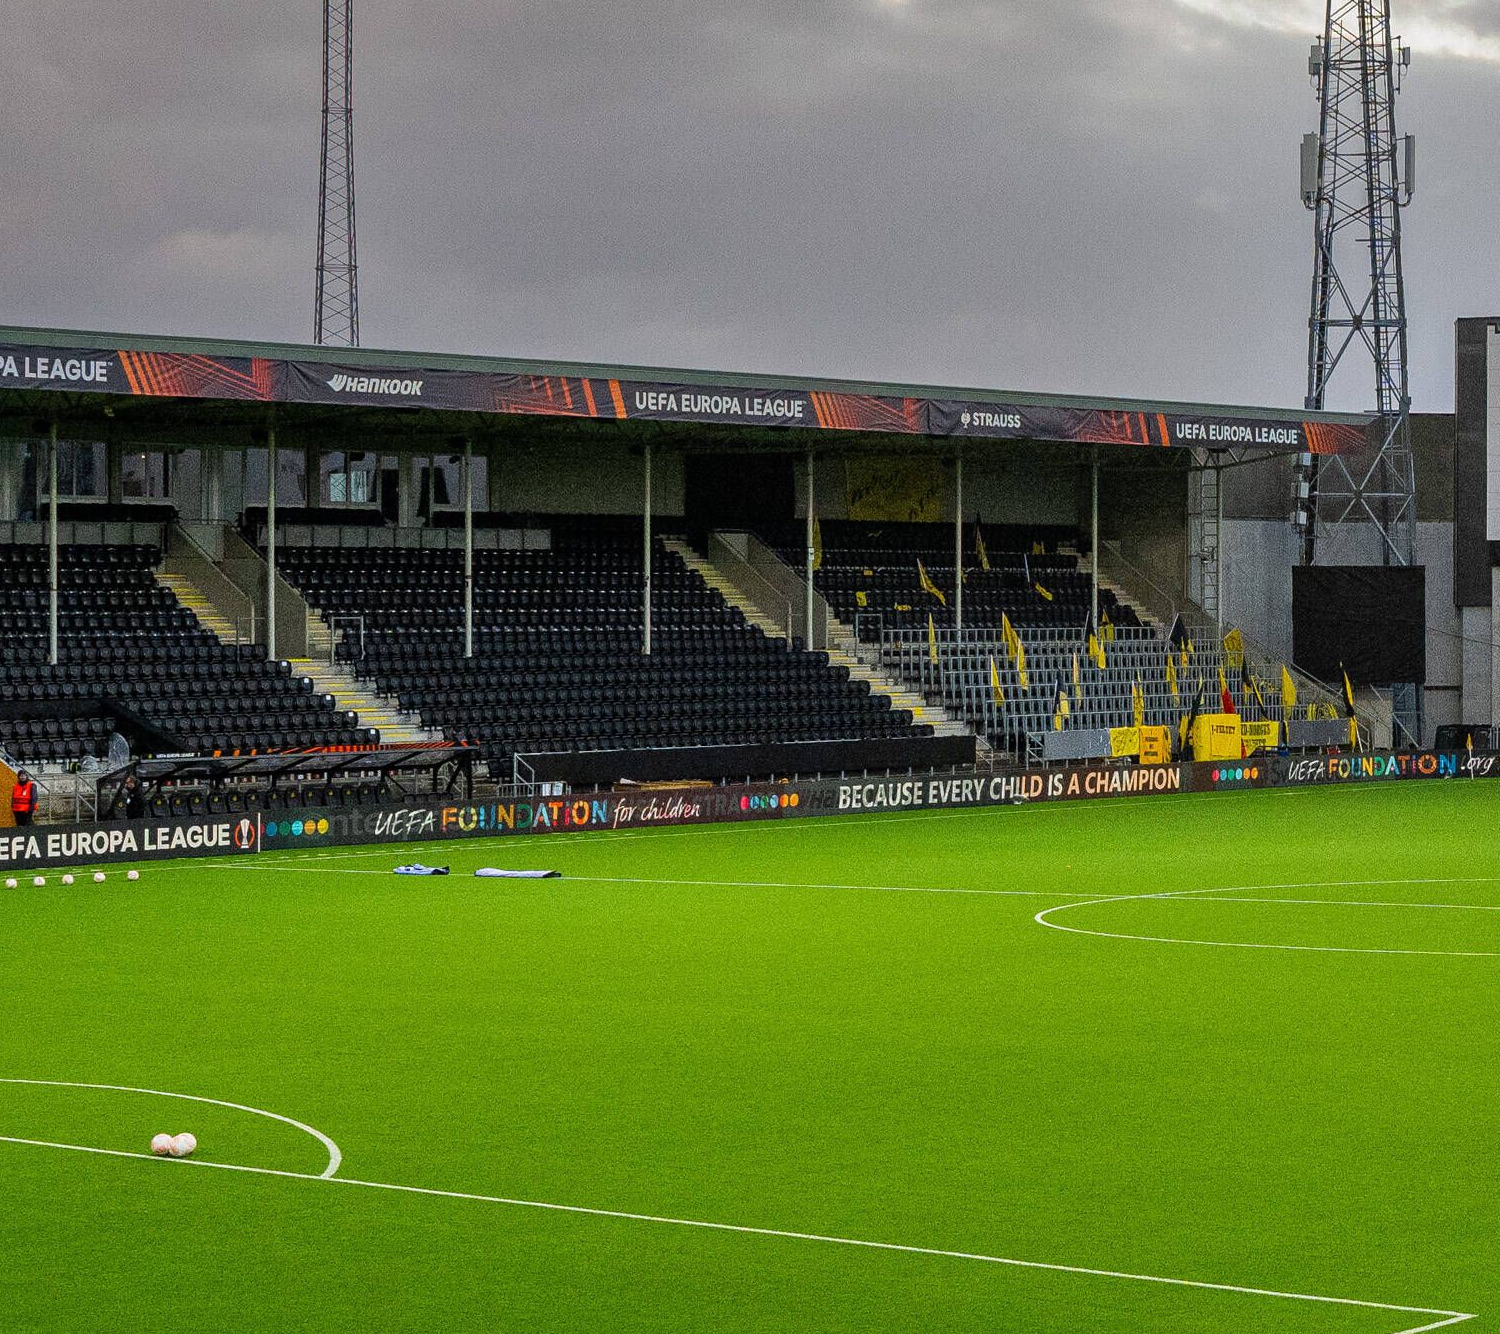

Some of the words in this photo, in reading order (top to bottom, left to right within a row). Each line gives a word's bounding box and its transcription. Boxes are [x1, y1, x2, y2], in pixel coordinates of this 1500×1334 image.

[635, 391, 678, 412] UEFA
[681, 394, 742, 415] EUROPA
[972, 412, 1021, 428] STRAUSS
[1176, 423, 1207, 440] UEFA
[1209, 425, 1253, 442] EUROPA
[1288, 760, 1326, 781] UEFA
[1328, 754, 1456, 778] FOUNDATION
[839, 781, 923, 810] BECAUSE
[928, 778, 983, 805] EVERY
[989, 774, 1043, 801] CHILD
[1048, 773, 1063, 797] IS
[1067, 772, 1081, 795] A
[1085, 768, 1180, 794] CHAMPION
[374, 808, 438, 837] UEFA
[441, 798, 608, 834] FOUNDATION
[613, 798, 635, 829] for
[640, 795, 700, 822] children
[47, 828, 138, 857] EUROPA
[144, 823, 231, 851] LEAGUE
